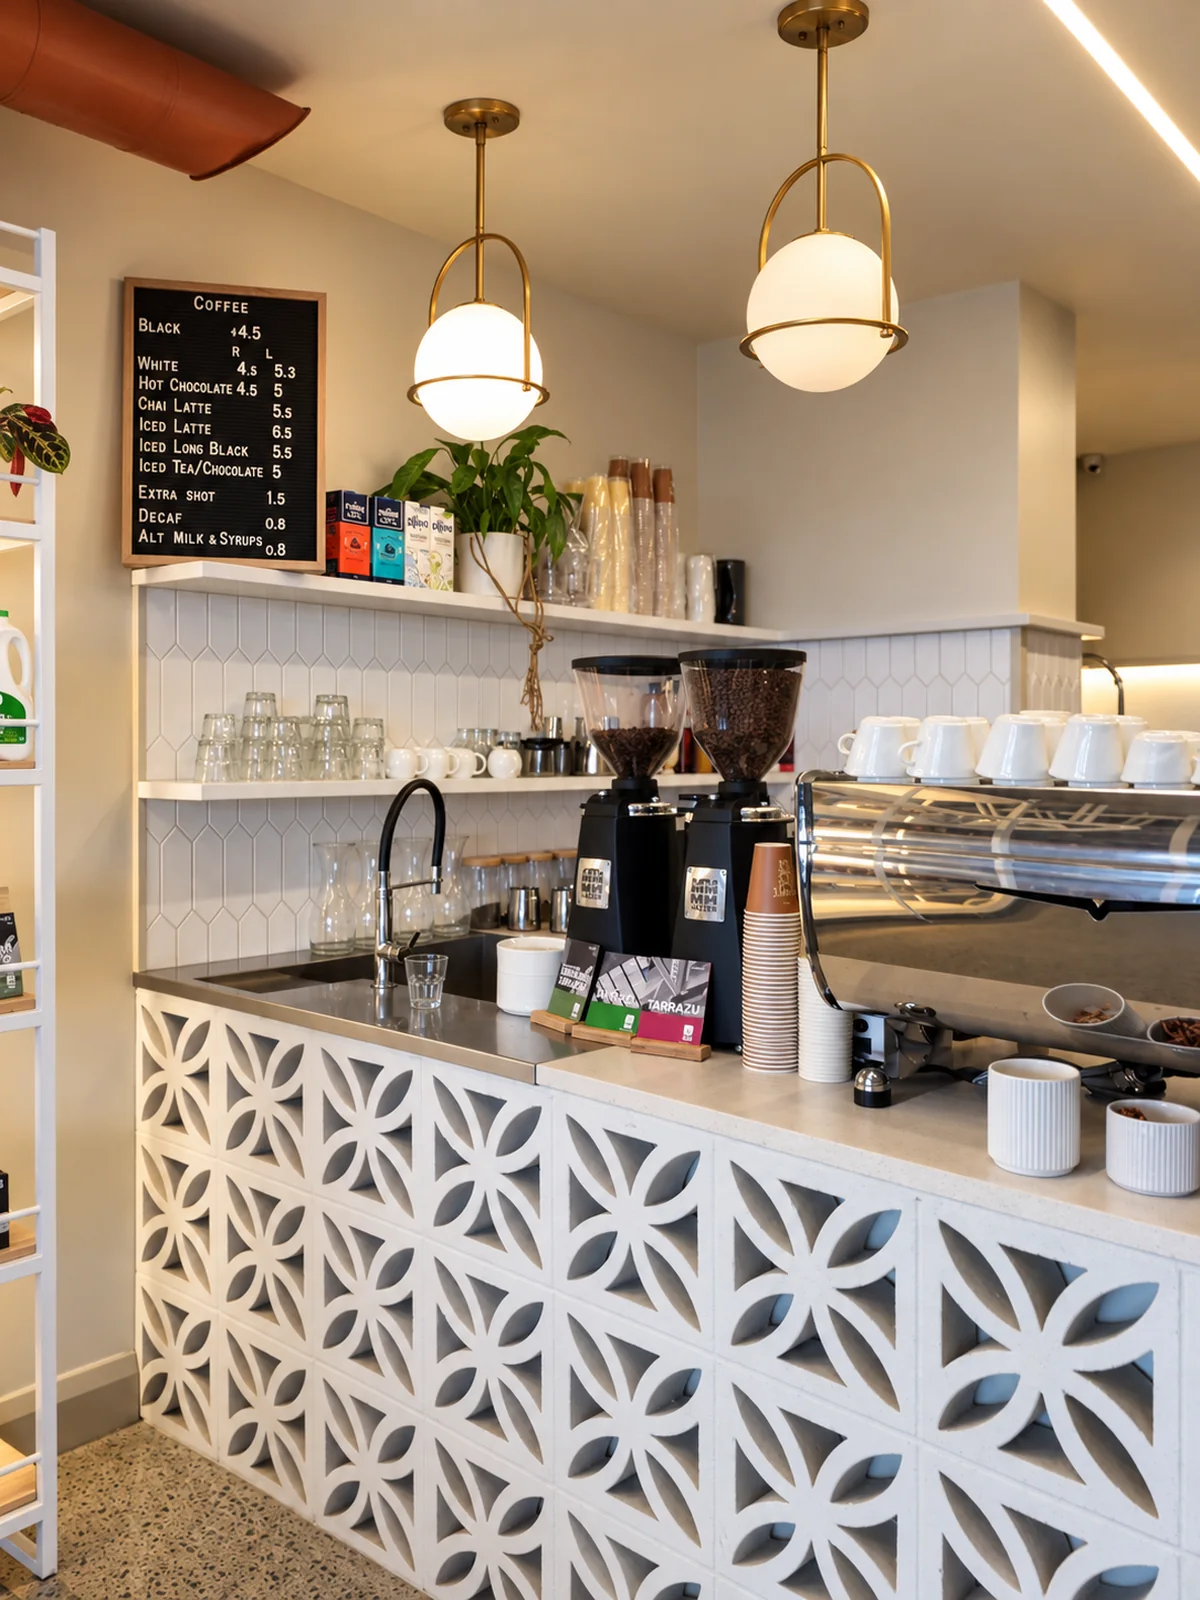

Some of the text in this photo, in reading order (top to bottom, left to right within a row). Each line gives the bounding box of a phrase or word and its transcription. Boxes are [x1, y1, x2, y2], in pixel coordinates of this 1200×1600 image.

[194, 296, 248, 314] COFFEE
[138, 318, 181, 334] BLACK
[232, 346, 273, 359] R L
[137, 356, 179, 372] WHITE
[274, 364, 296, 379] 5.3
[139, 376, 283, 397] HOT CHOCOLATE 4.5 5
[138, 396, 166, 412] CHAI
[174, 398, 212, 415] LATTE
[139, 417, 292, 439] ICED LATTE 6.5
[139, 438, 292, 459] ICED LONG BLACK 5.5
[139, 458, 281, 479] ICED TEA/CHOCOLATE 5
[138, 485, 285, 505] EXTRA SHOT 1.5
[138, 508, 286, 530] DECAF 0.8
[138, 529, 286, 557] ALT MILK & SYRUPS 0.8
[648, 1000, 700, 1015] TARRAZU
